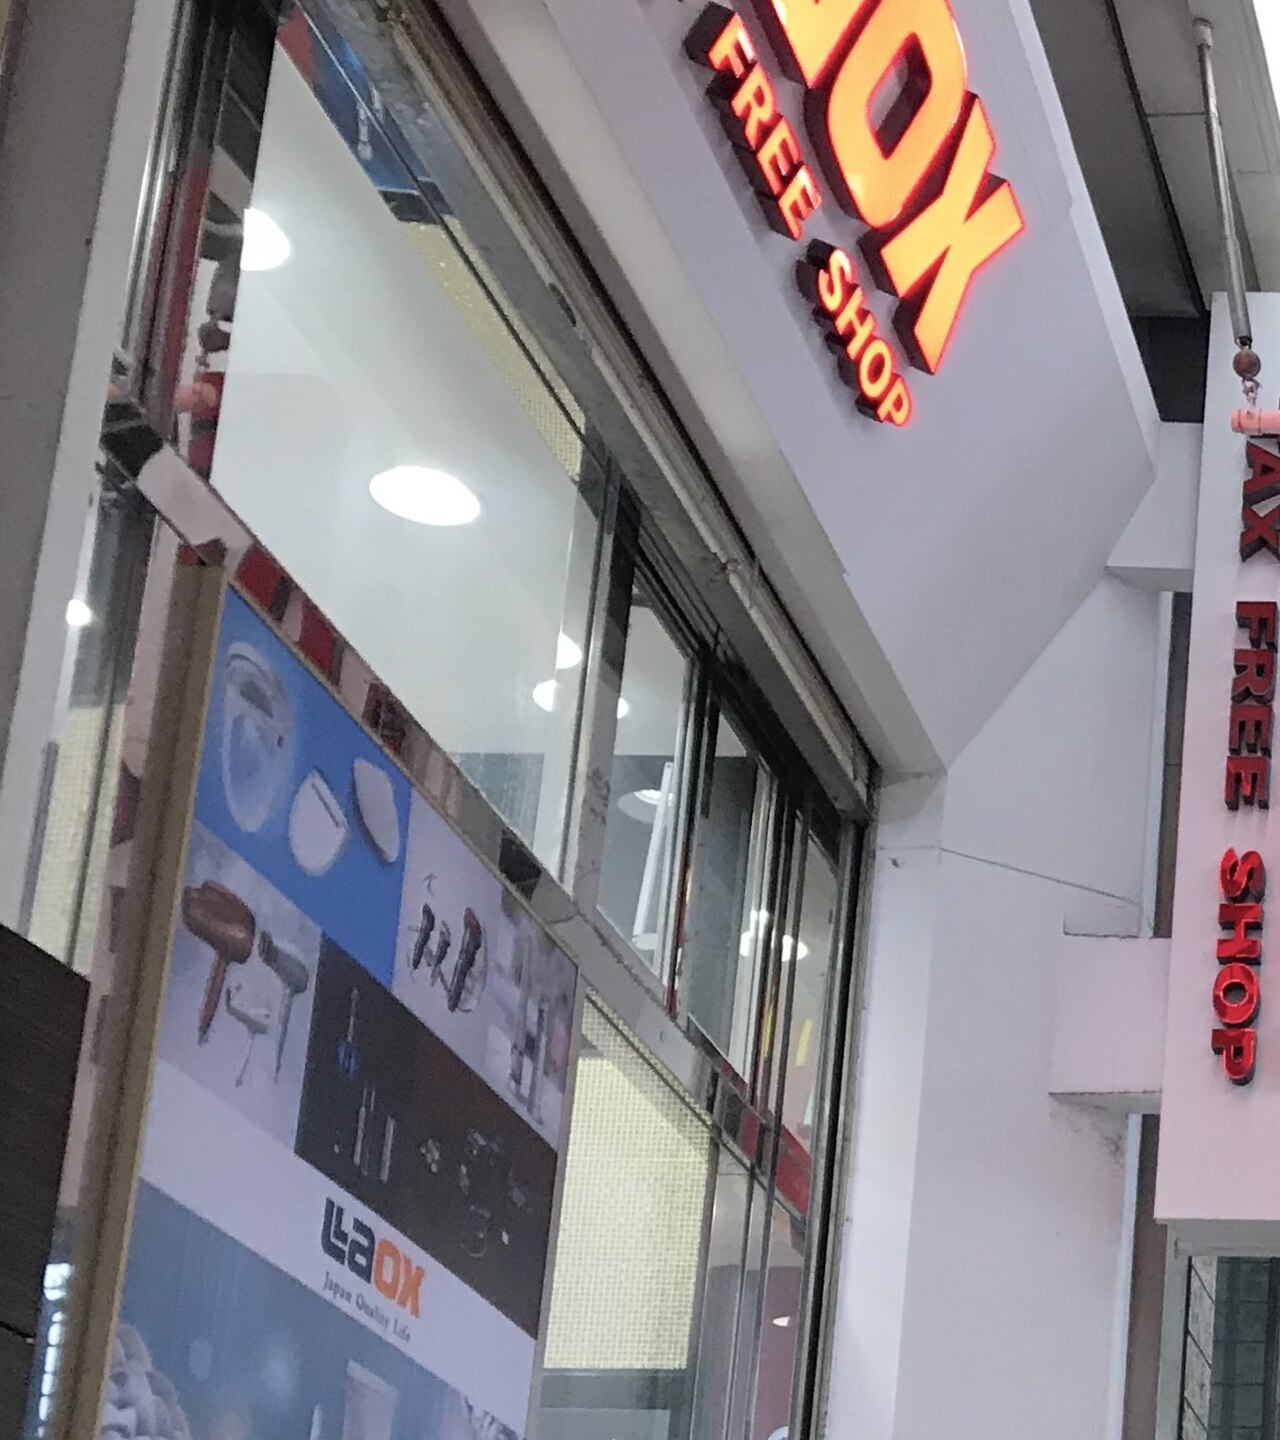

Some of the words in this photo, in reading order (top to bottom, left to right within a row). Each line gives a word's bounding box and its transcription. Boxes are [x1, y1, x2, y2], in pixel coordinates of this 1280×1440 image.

[706, 12, 822, 240] FREE
[816, 247, 912, 427] SHOP
[768, 0, 1026, 375] OX
[1225, 601, 1280, 810] FREE
[1211, 847, 1265, 1086] SHOP
[322, 1270, 353, 1304] Japan
[355, 1292, 391, 1330] Quality
[393, 1319, 412, 1343] Life
